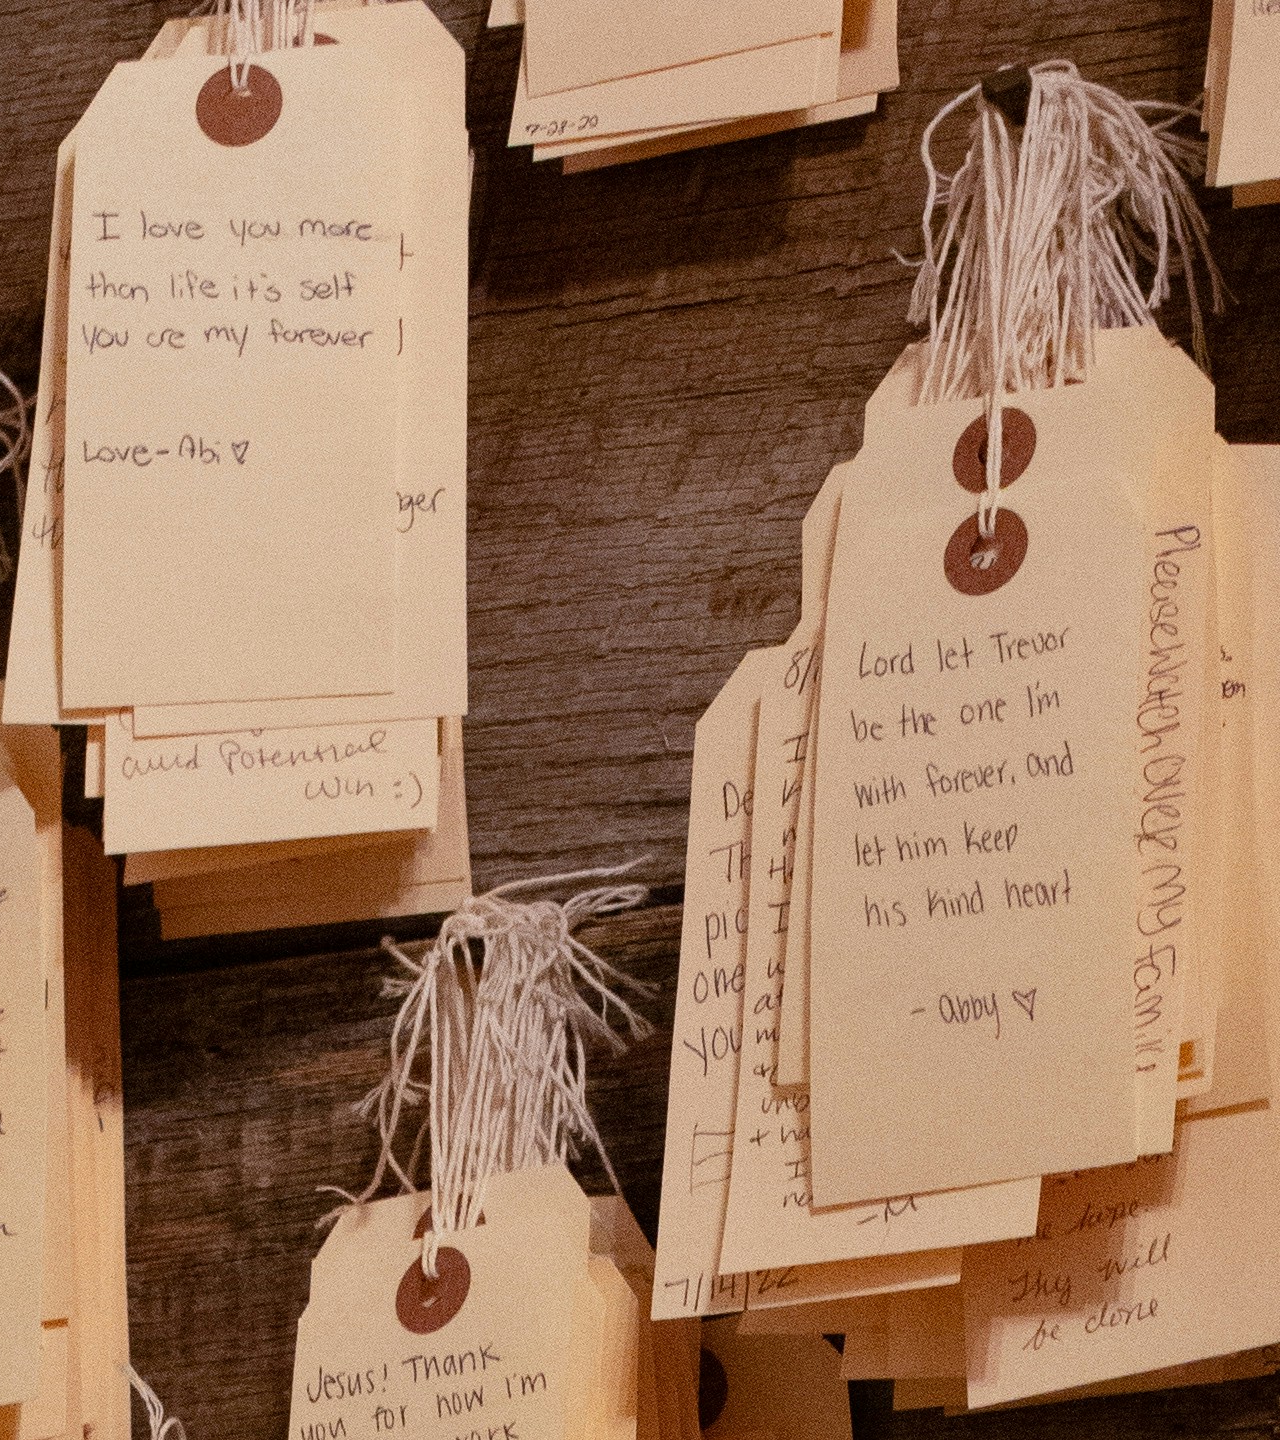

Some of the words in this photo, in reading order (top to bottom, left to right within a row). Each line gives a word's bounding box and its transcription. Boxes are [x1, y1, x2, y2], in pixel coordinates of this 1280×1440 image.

[94, 212, 120, 242] I
[140, 210, 204, 240] love
[230, 218, 282, 248] you
[299, 218, 373, 242] more
[87, 273, 150, 301] than
[170, 271, 219, 299] life
[232, 274, 281, 300] it's
[300, 273, 354, 300] self
[146, 328, 185, 348] are
[204, 326, 248, 356] my
[270, 322, 373, 347] forever
[858, 643, 916, 680] Lord
[937, 640, 974, 672] let
[990, 627, 1070, 662] Trevor
[850, 710, 884, 742] be
[898, 705, 938, 738] the
[959, 697, 1008, 726] one
[1026, 682, 1061, 718] I'm
[854, 775, 907, 808] with
[1026, 747, 1074, 778] and
[853, 834, 886, 868] let
[895, 834, 948, 863] him
[962, 822, 1019, 857] keep
[864, 894, 908, 927] his
[926, 882, 985, 918] kind
[1004, 869, 1072, 908] heart
[1085, 1296, 1158, 1336] done
[307, 1364, 388, 1403] Jesus!
[402, 1345, 501, 1383] Thank
[372, 1406, 407, 1432] for
[436, 1388, 484, 1418] how
[505, 1372, 548, 1400] I'm
